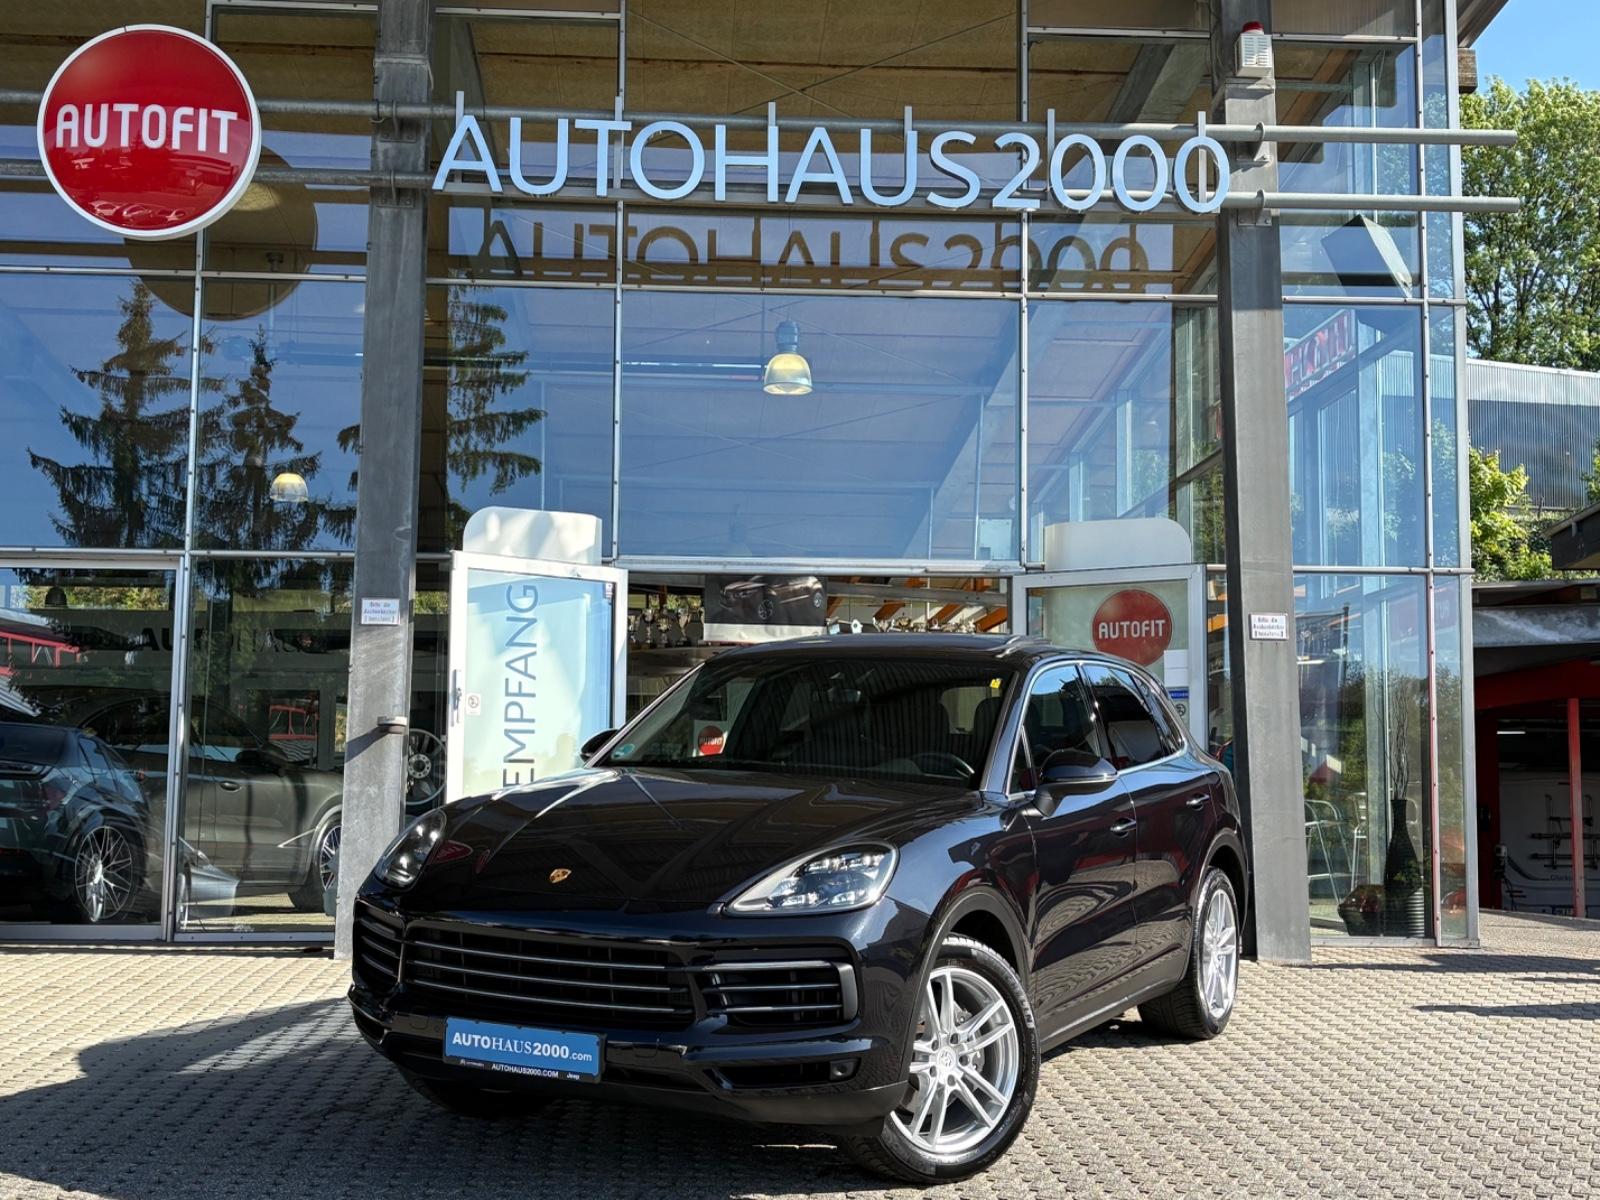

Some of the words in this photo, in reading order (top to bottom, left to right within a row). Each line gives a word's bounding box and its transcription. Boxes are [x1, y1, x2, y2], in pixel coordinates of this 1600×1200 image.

[56, 103, 238, 154] AUTOFIT
[432, 114, 1230, 213] AUTOHAUS2000
[1098, 619, 1166, 639] AUTOFIT
[503, 584, 539, 788] EMPFANG
[452, 1032, 593, 1062] AUTOHAUS2000.com
[491, 1063, 559, 1078] AUTOHAUS2000.COM
